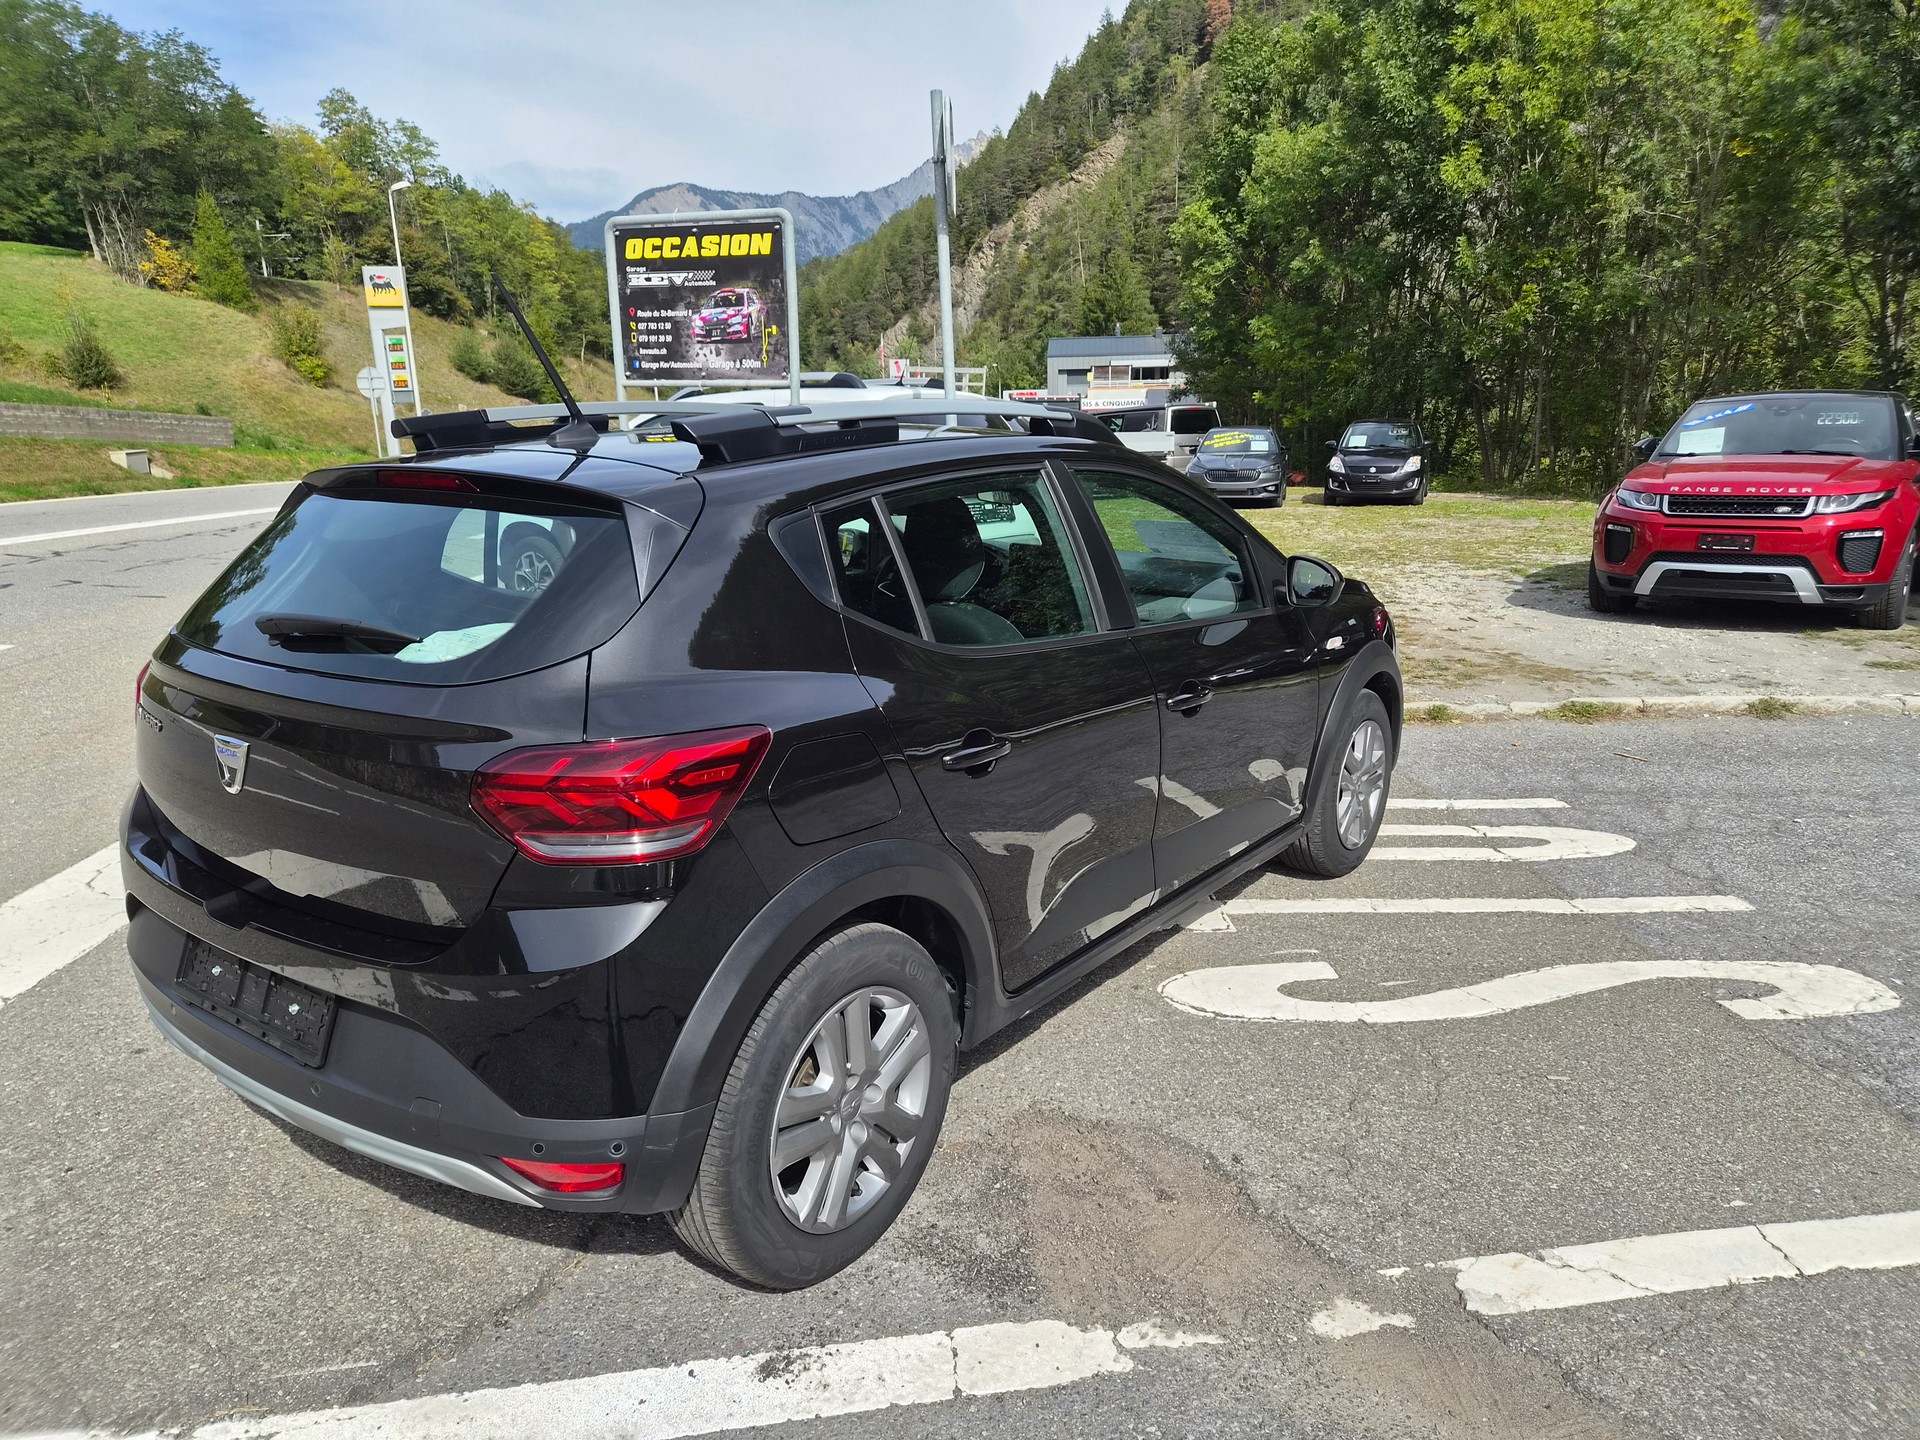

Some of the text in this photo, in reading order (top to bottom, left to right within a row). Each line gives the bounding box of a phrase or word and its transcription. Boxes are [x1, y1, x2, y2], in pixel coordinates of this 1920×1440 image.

[625, 232, 773, 260] OCCASION
[626, 265, 647, 273] Garage
[637, 310, 652, 318] Route
[653, 310, 660, 318] du
[660, 309, 688, 318] St-Bernard
[637, 322, 647, 330] 027
[658, 322, 664, 330] 12
[665, 322, 672, 330] 50
[640, 347, 667, 355] kevauto.ch
[641, 361, 659, 370] Garage
[709, 358, 761, 371] Garage à 500m
